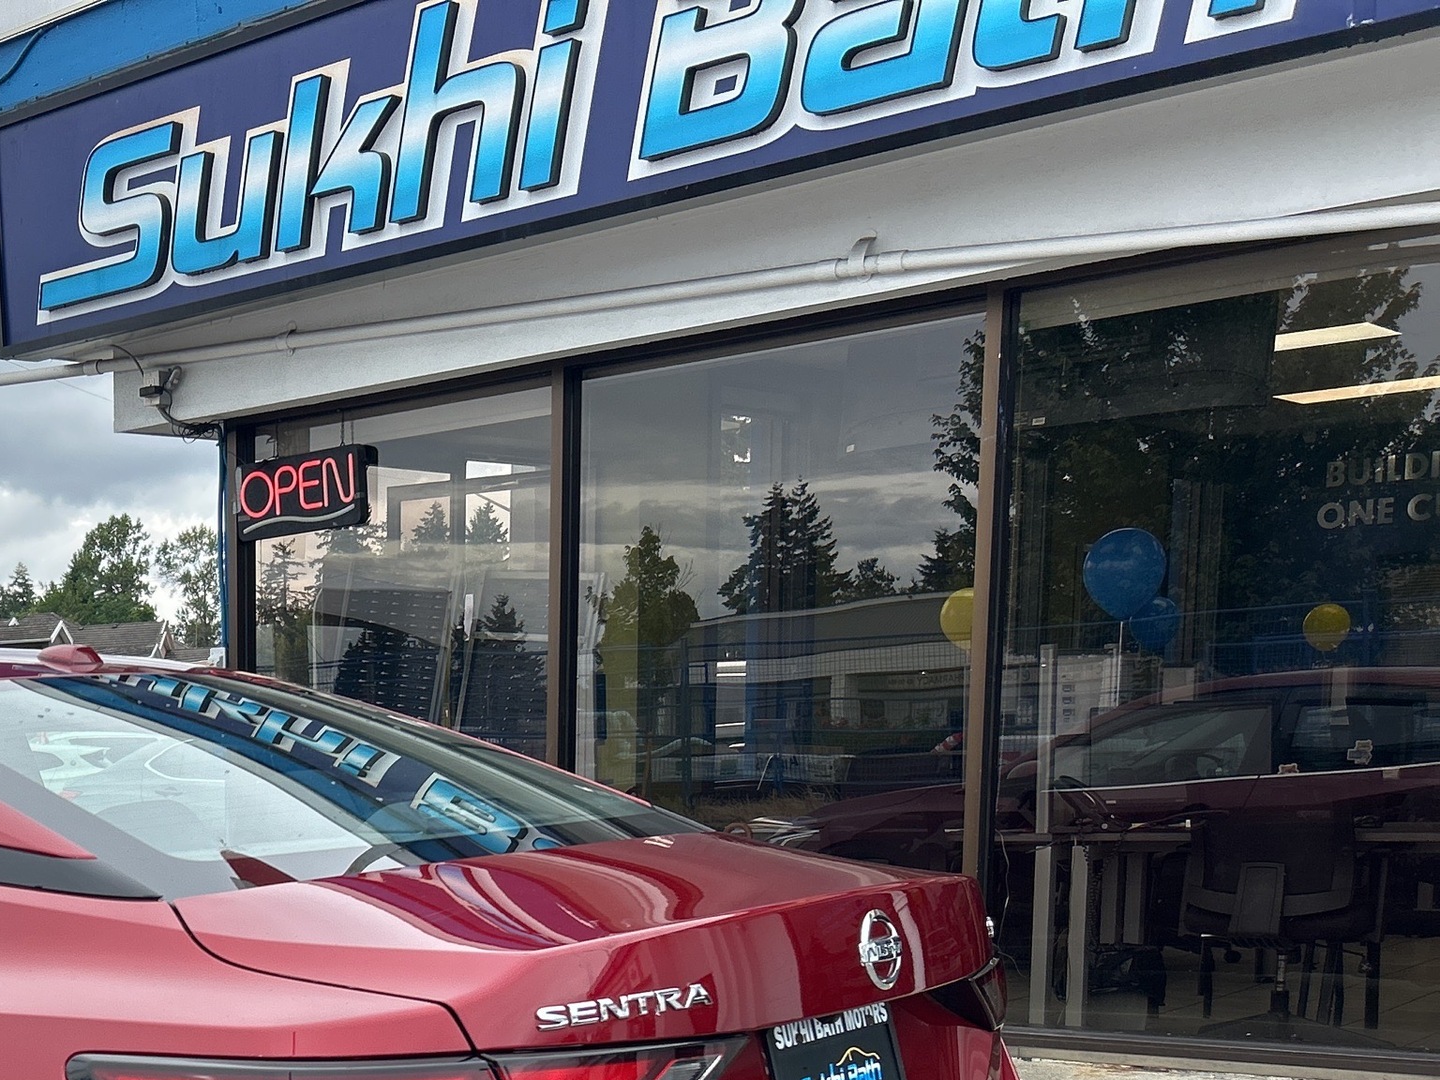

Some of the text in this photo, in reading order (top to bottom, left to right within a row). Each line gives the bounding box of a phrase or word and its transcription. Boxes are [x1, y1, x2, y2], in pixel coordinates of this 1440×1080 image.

[38, 0, 1266, 312] Sukhi Ba
[240, 453, 356, 519] OPEN
[1317, 497, 1395, 529] ONE
[535, 983, 713, 1032] SENTRA
[773, 1019, 815, 1050] SUKHI
